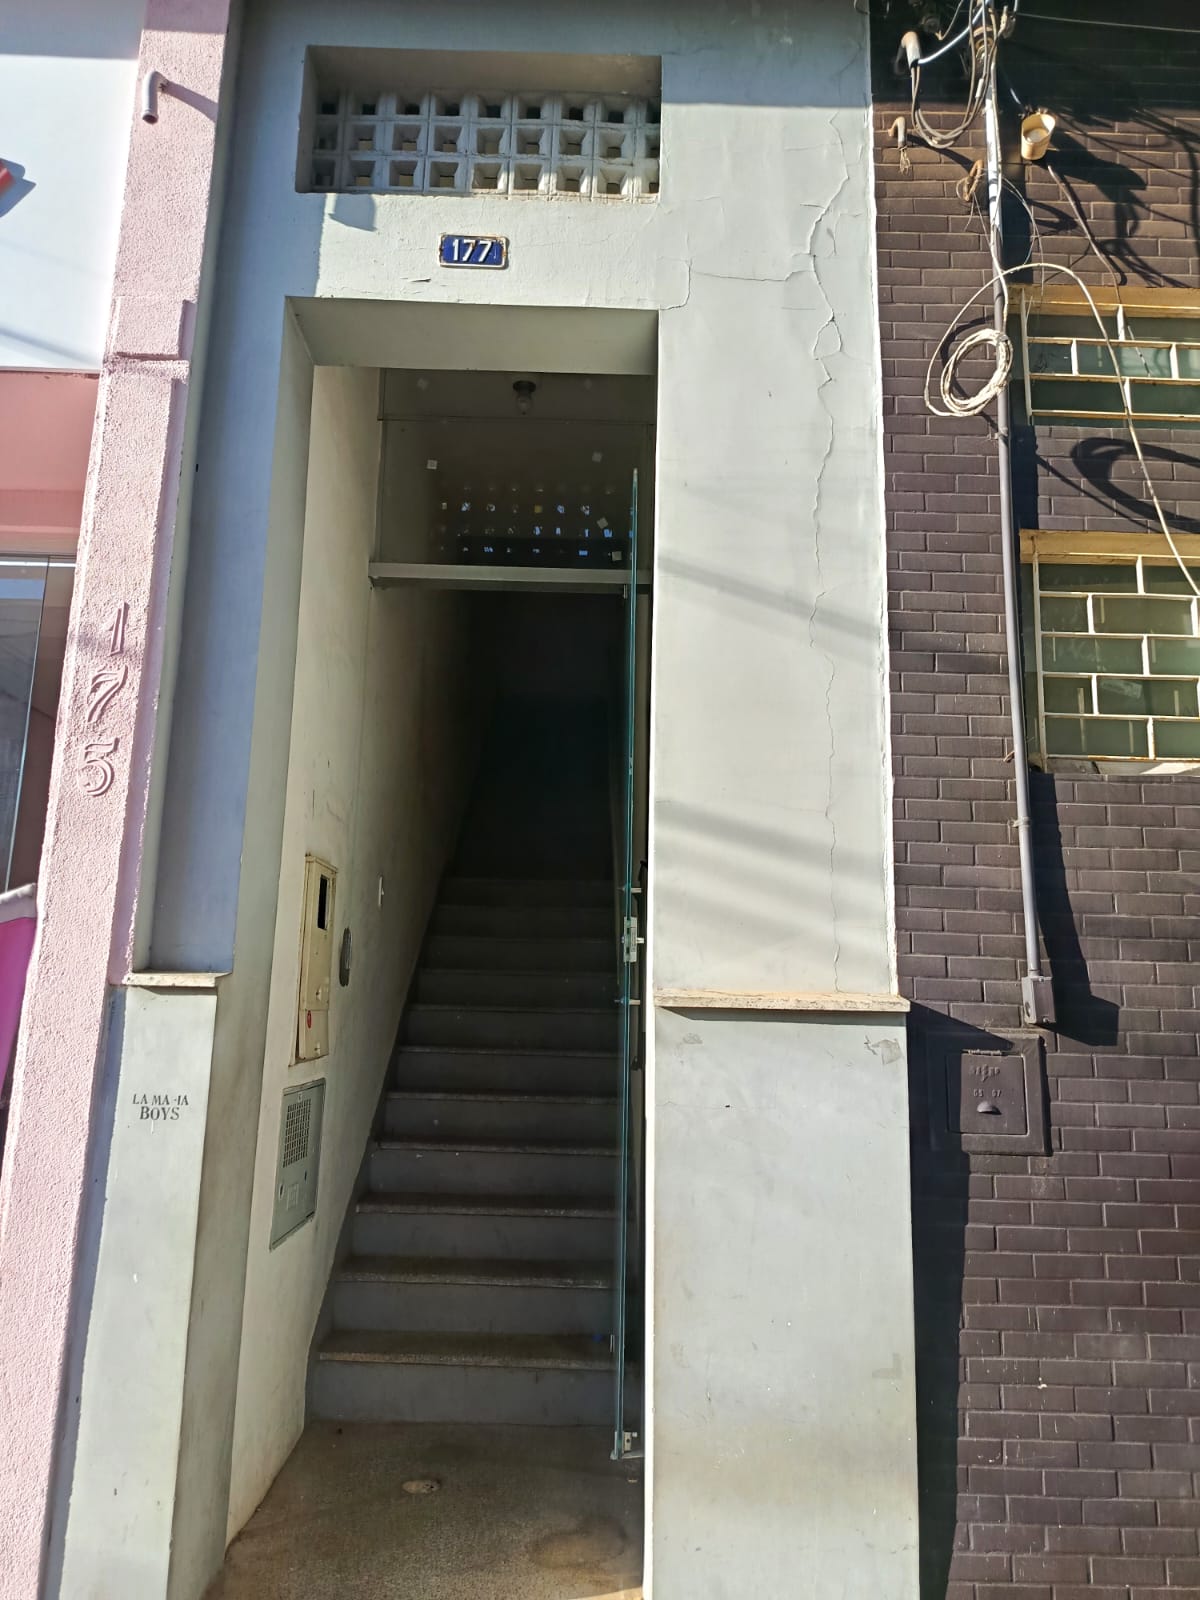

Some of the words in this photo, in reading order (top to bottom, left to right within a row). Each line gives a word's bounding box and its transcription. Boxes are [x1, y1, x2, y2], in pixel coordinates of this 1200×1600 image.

[452, 238, 493, 262] 177
[78, 601, 129, 797] 175
[132, 1093, 148, 1105] LA
[151, 1094, 189, 1106] MAIA
[139, 1106, 180, 1120] BOYS
